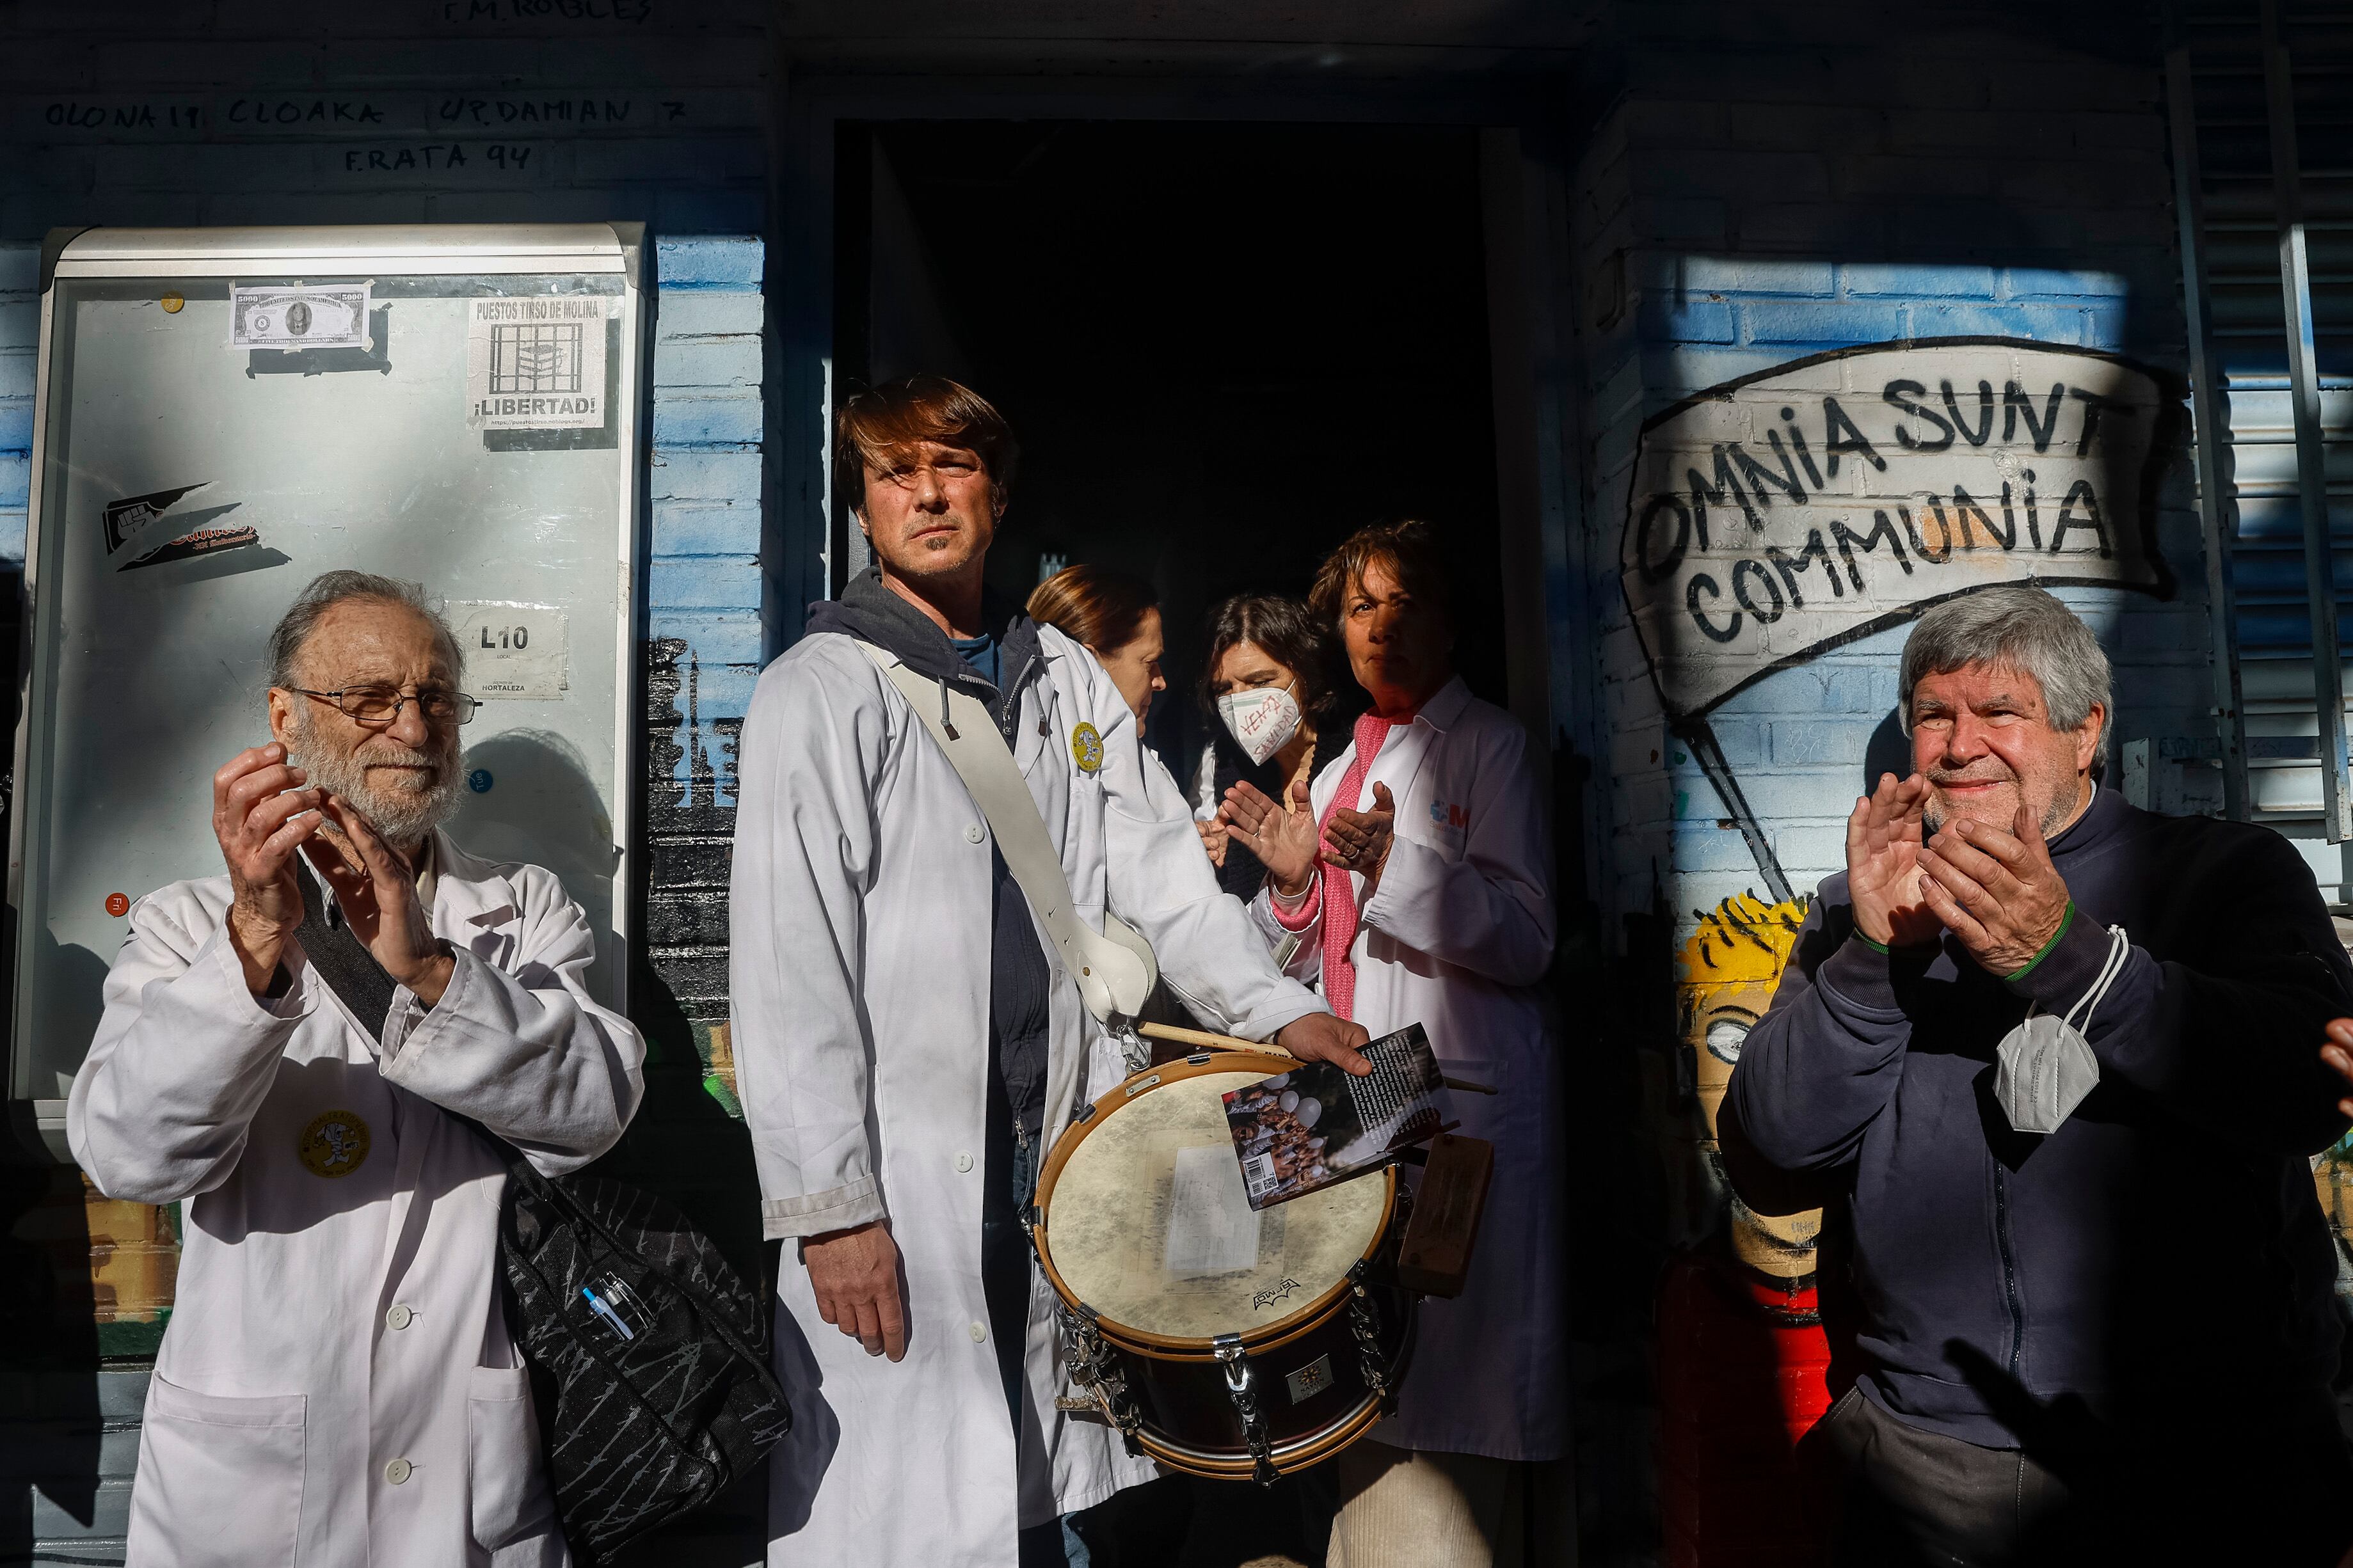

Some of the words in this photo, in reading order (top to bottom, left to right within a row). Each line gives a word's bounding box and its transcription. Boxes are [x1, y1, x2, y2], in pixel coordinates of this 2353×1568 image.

[228, 99, 385, 123] CLOAKA
[486, 145, 531, 170] 94
[477, 302, 517, 320] PUESTOS
[520, 301, 547, 319] TIRSO
[549, 301, 561, 319] DE
[564, 300, 598, 319] MOLINA
[474, 397, 595, 416] ¡LIBERTAD!
[1883, 378, 2136, 459] SUNT
[481, 626, 528, 649] L10
[475, 772, 484, 791] Tue
[112, 898, 122, 910] Fri
[1257, 1281, 1291, 1303] REMO
